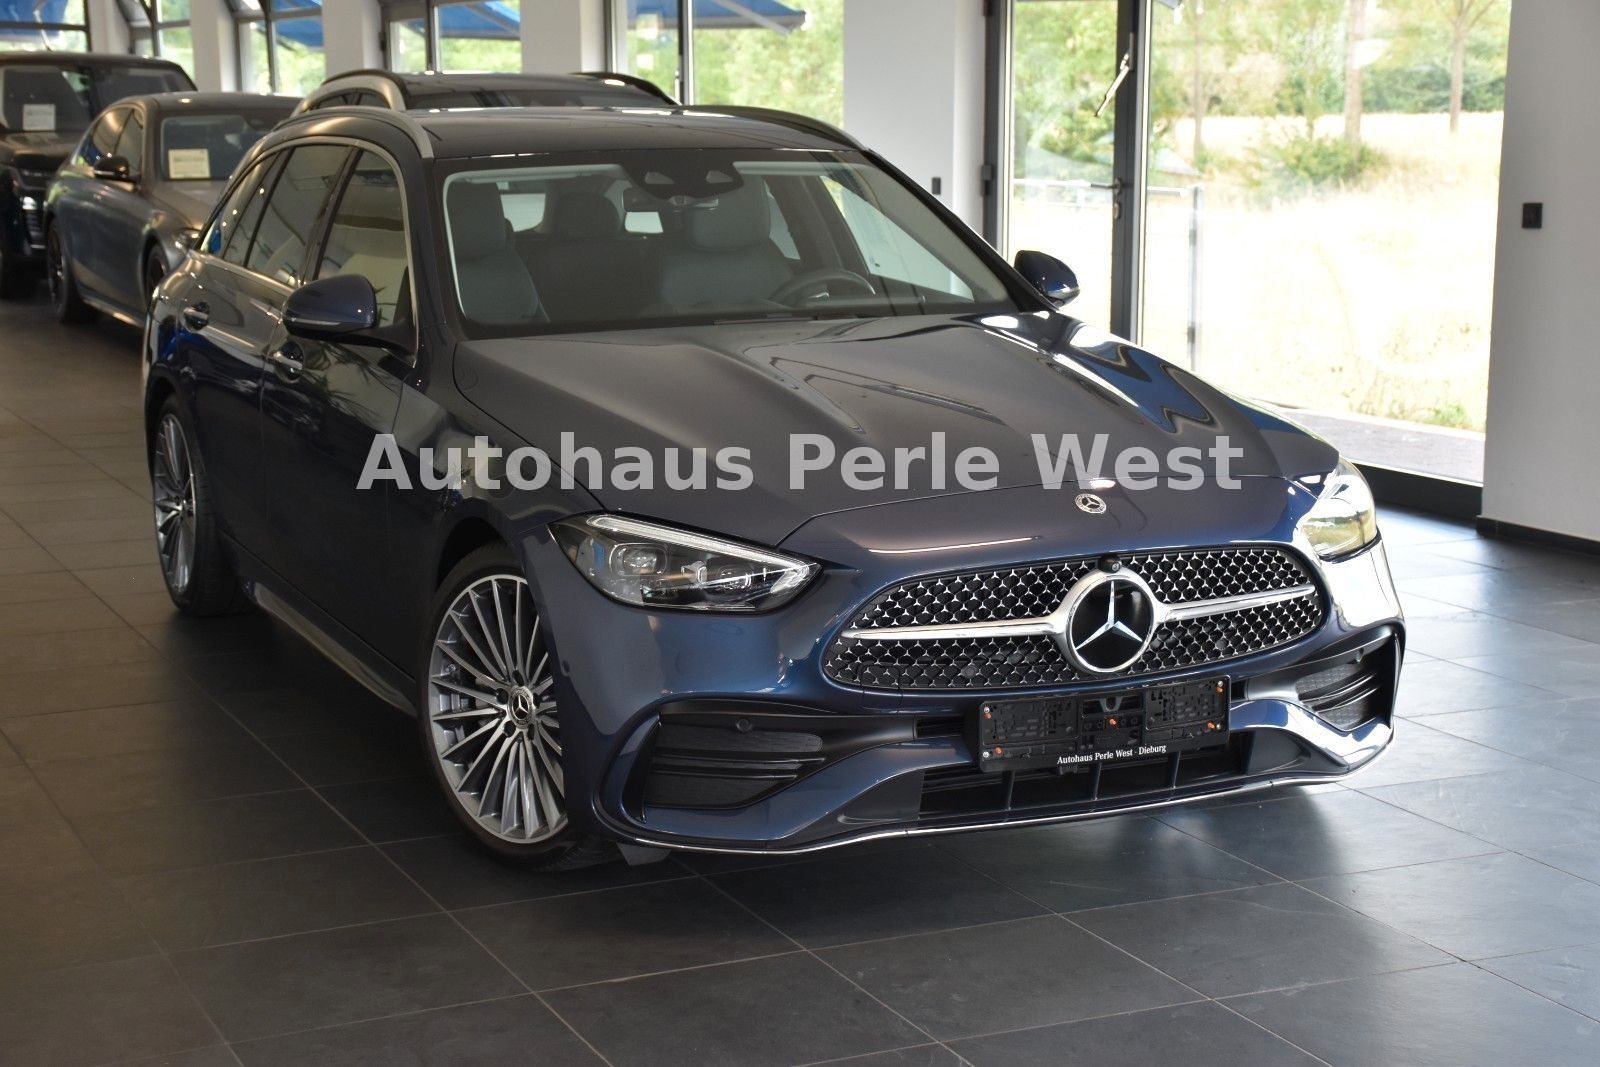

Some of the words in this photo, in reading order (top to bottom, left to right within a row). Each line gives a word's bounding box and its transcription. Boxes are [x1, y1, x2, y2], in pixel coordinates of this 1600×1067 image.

[1056, 753, 1093, 765] Autohaus
[1094, 750, 1114, 761] Perle
[1115, 748, 1133, 758] West
[1138, 744, 1167, 755] Dieburg
